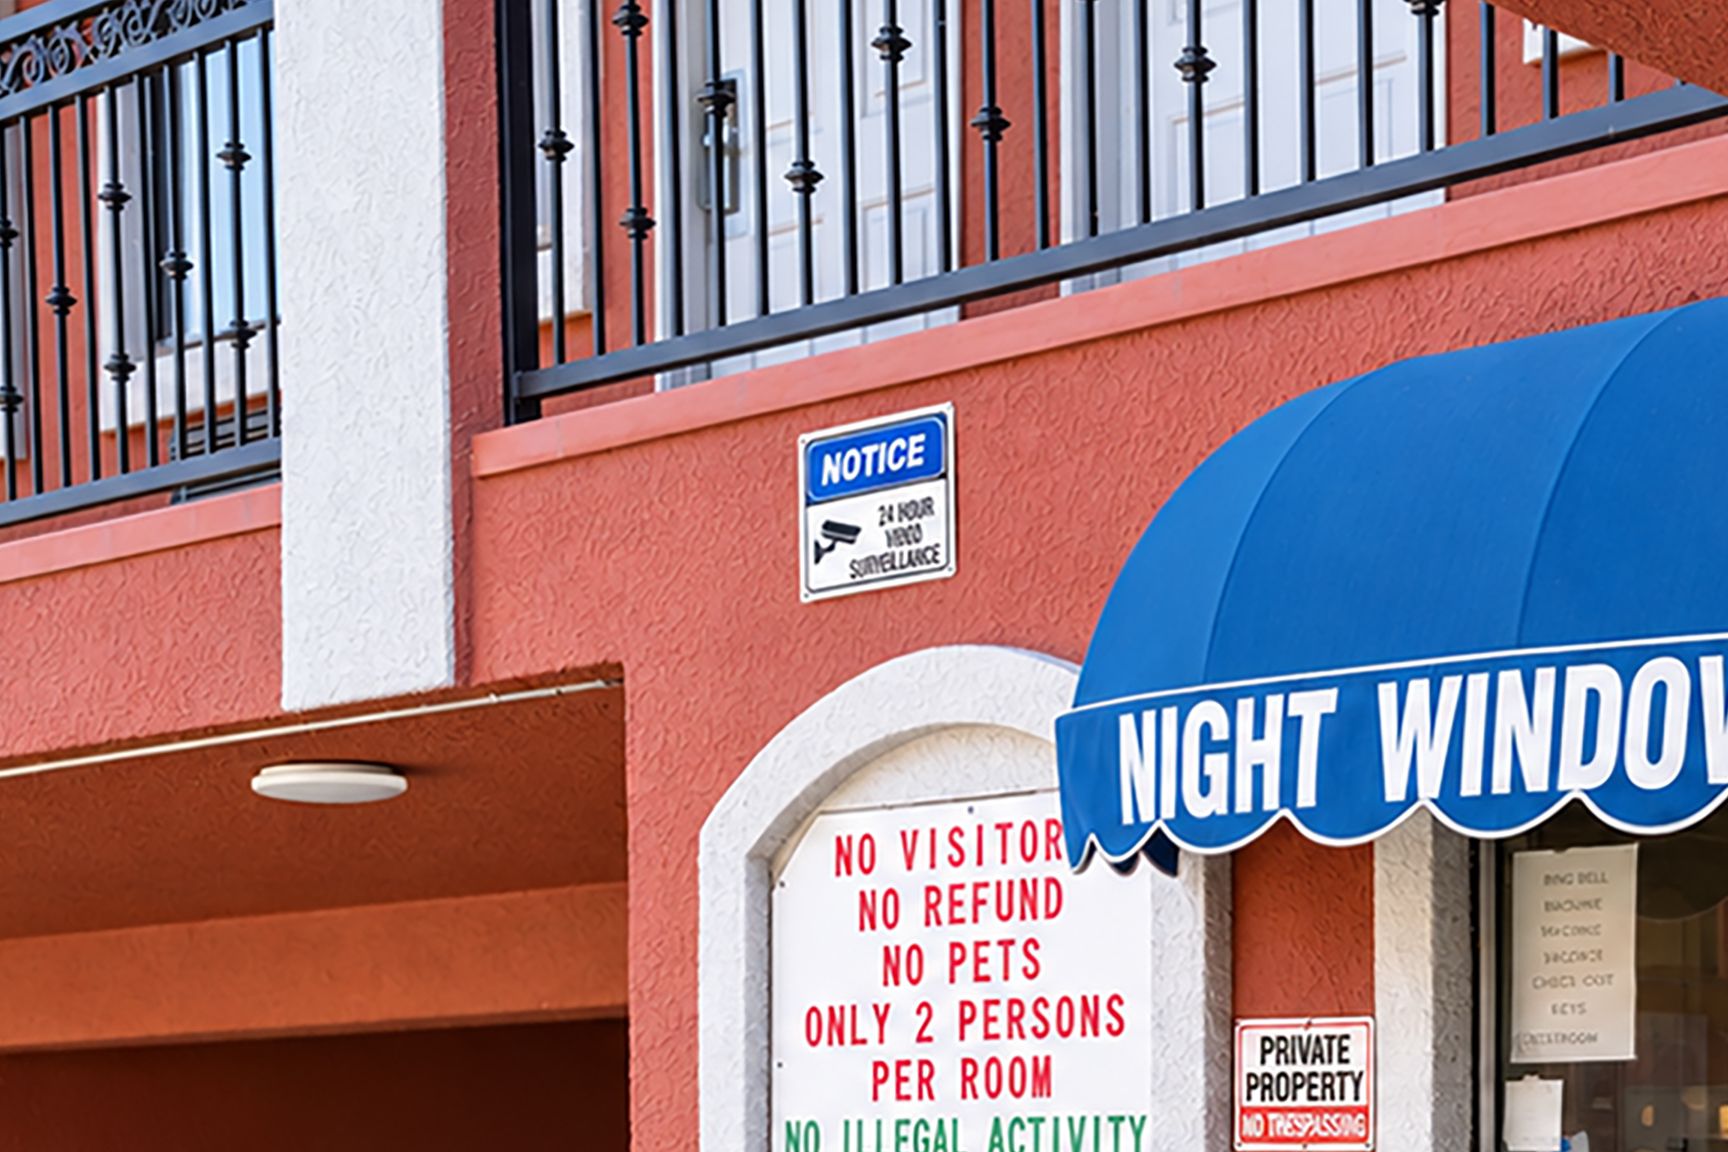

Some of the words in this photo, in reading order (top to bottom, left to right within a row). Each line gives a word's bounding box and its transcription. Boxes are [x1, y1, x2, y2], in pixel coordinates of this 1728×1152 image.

[822, 433, 926, 487] NOTICE
[1118, 688, 1338, 826] NIGHT
[836, 833, 875, 877] NO
[901, 817, 1063, 871] VISITOR
[859, 888, 899, 931] NO
[925, 877, 1062, 927] REFUND
[883, 944, 923, 986] NO
[949, 938, 1040, 984] PETS
[806, 1003, 890, 1047] ONLY
[916, 1001, 933, 1043] 2
[959, 994, 1124, 1041] PERSONS
[1261, 1034, 1350, 1065] PRIVATE
[873, 1059, 934, 1101] PER
[961, 1056, 1051, 1099] ROOM
[1247, 1071, 1363, 1101] PROPERTY
